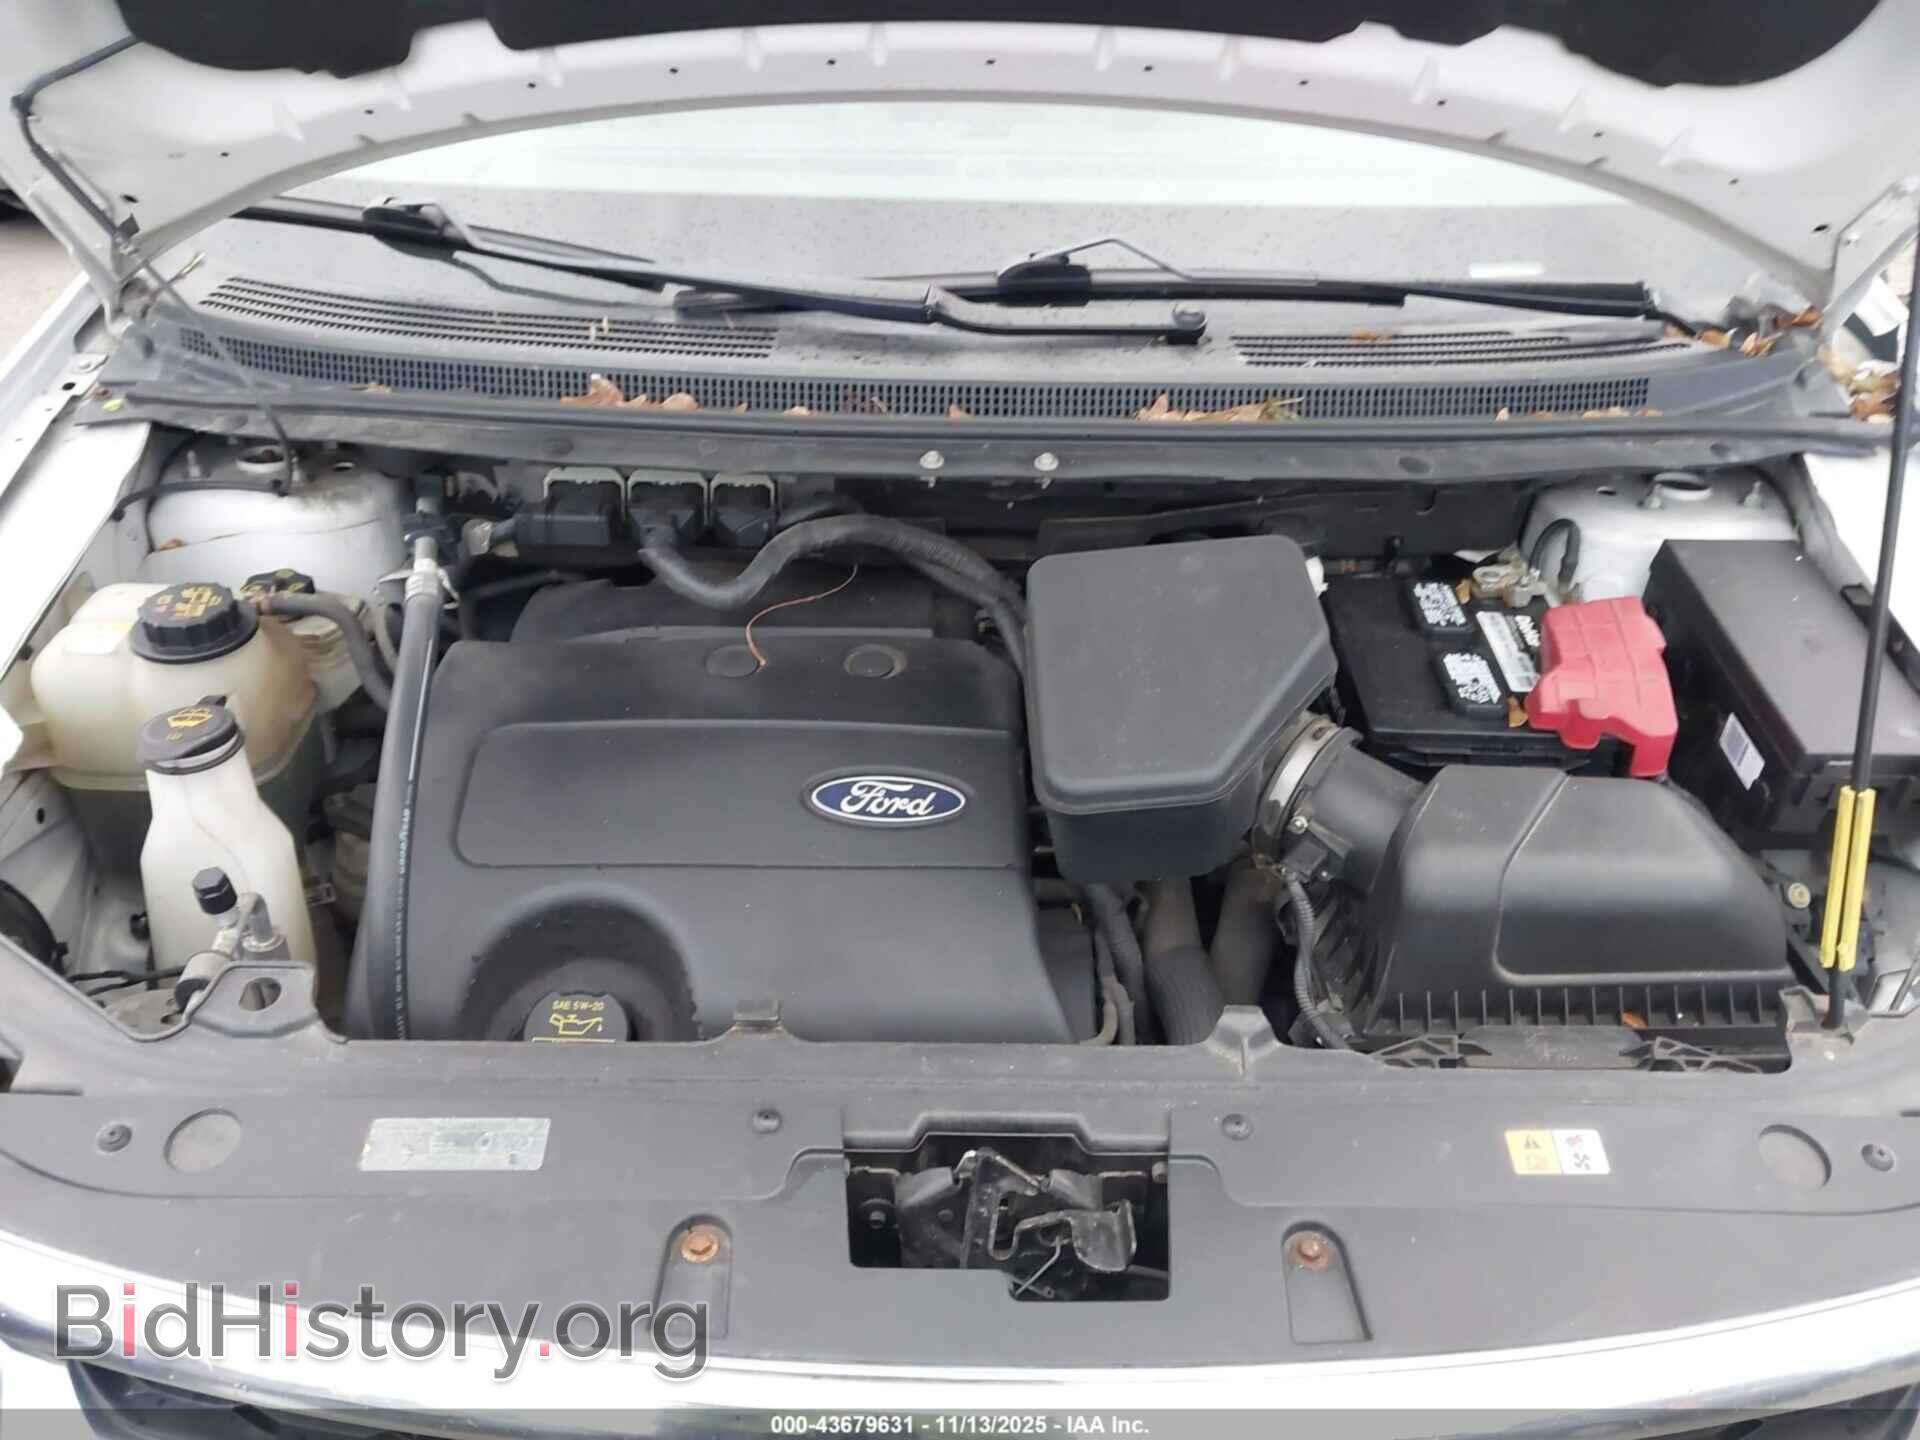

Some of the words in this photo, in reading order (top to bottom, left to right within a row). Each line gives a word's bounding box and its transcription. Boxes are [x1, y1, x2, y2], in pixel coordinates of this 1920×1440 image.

[840, 781, 936, 815] Ford
[551, 999, 571, 1010] SAE
[573, 999, 605, 1011] 5W-20
